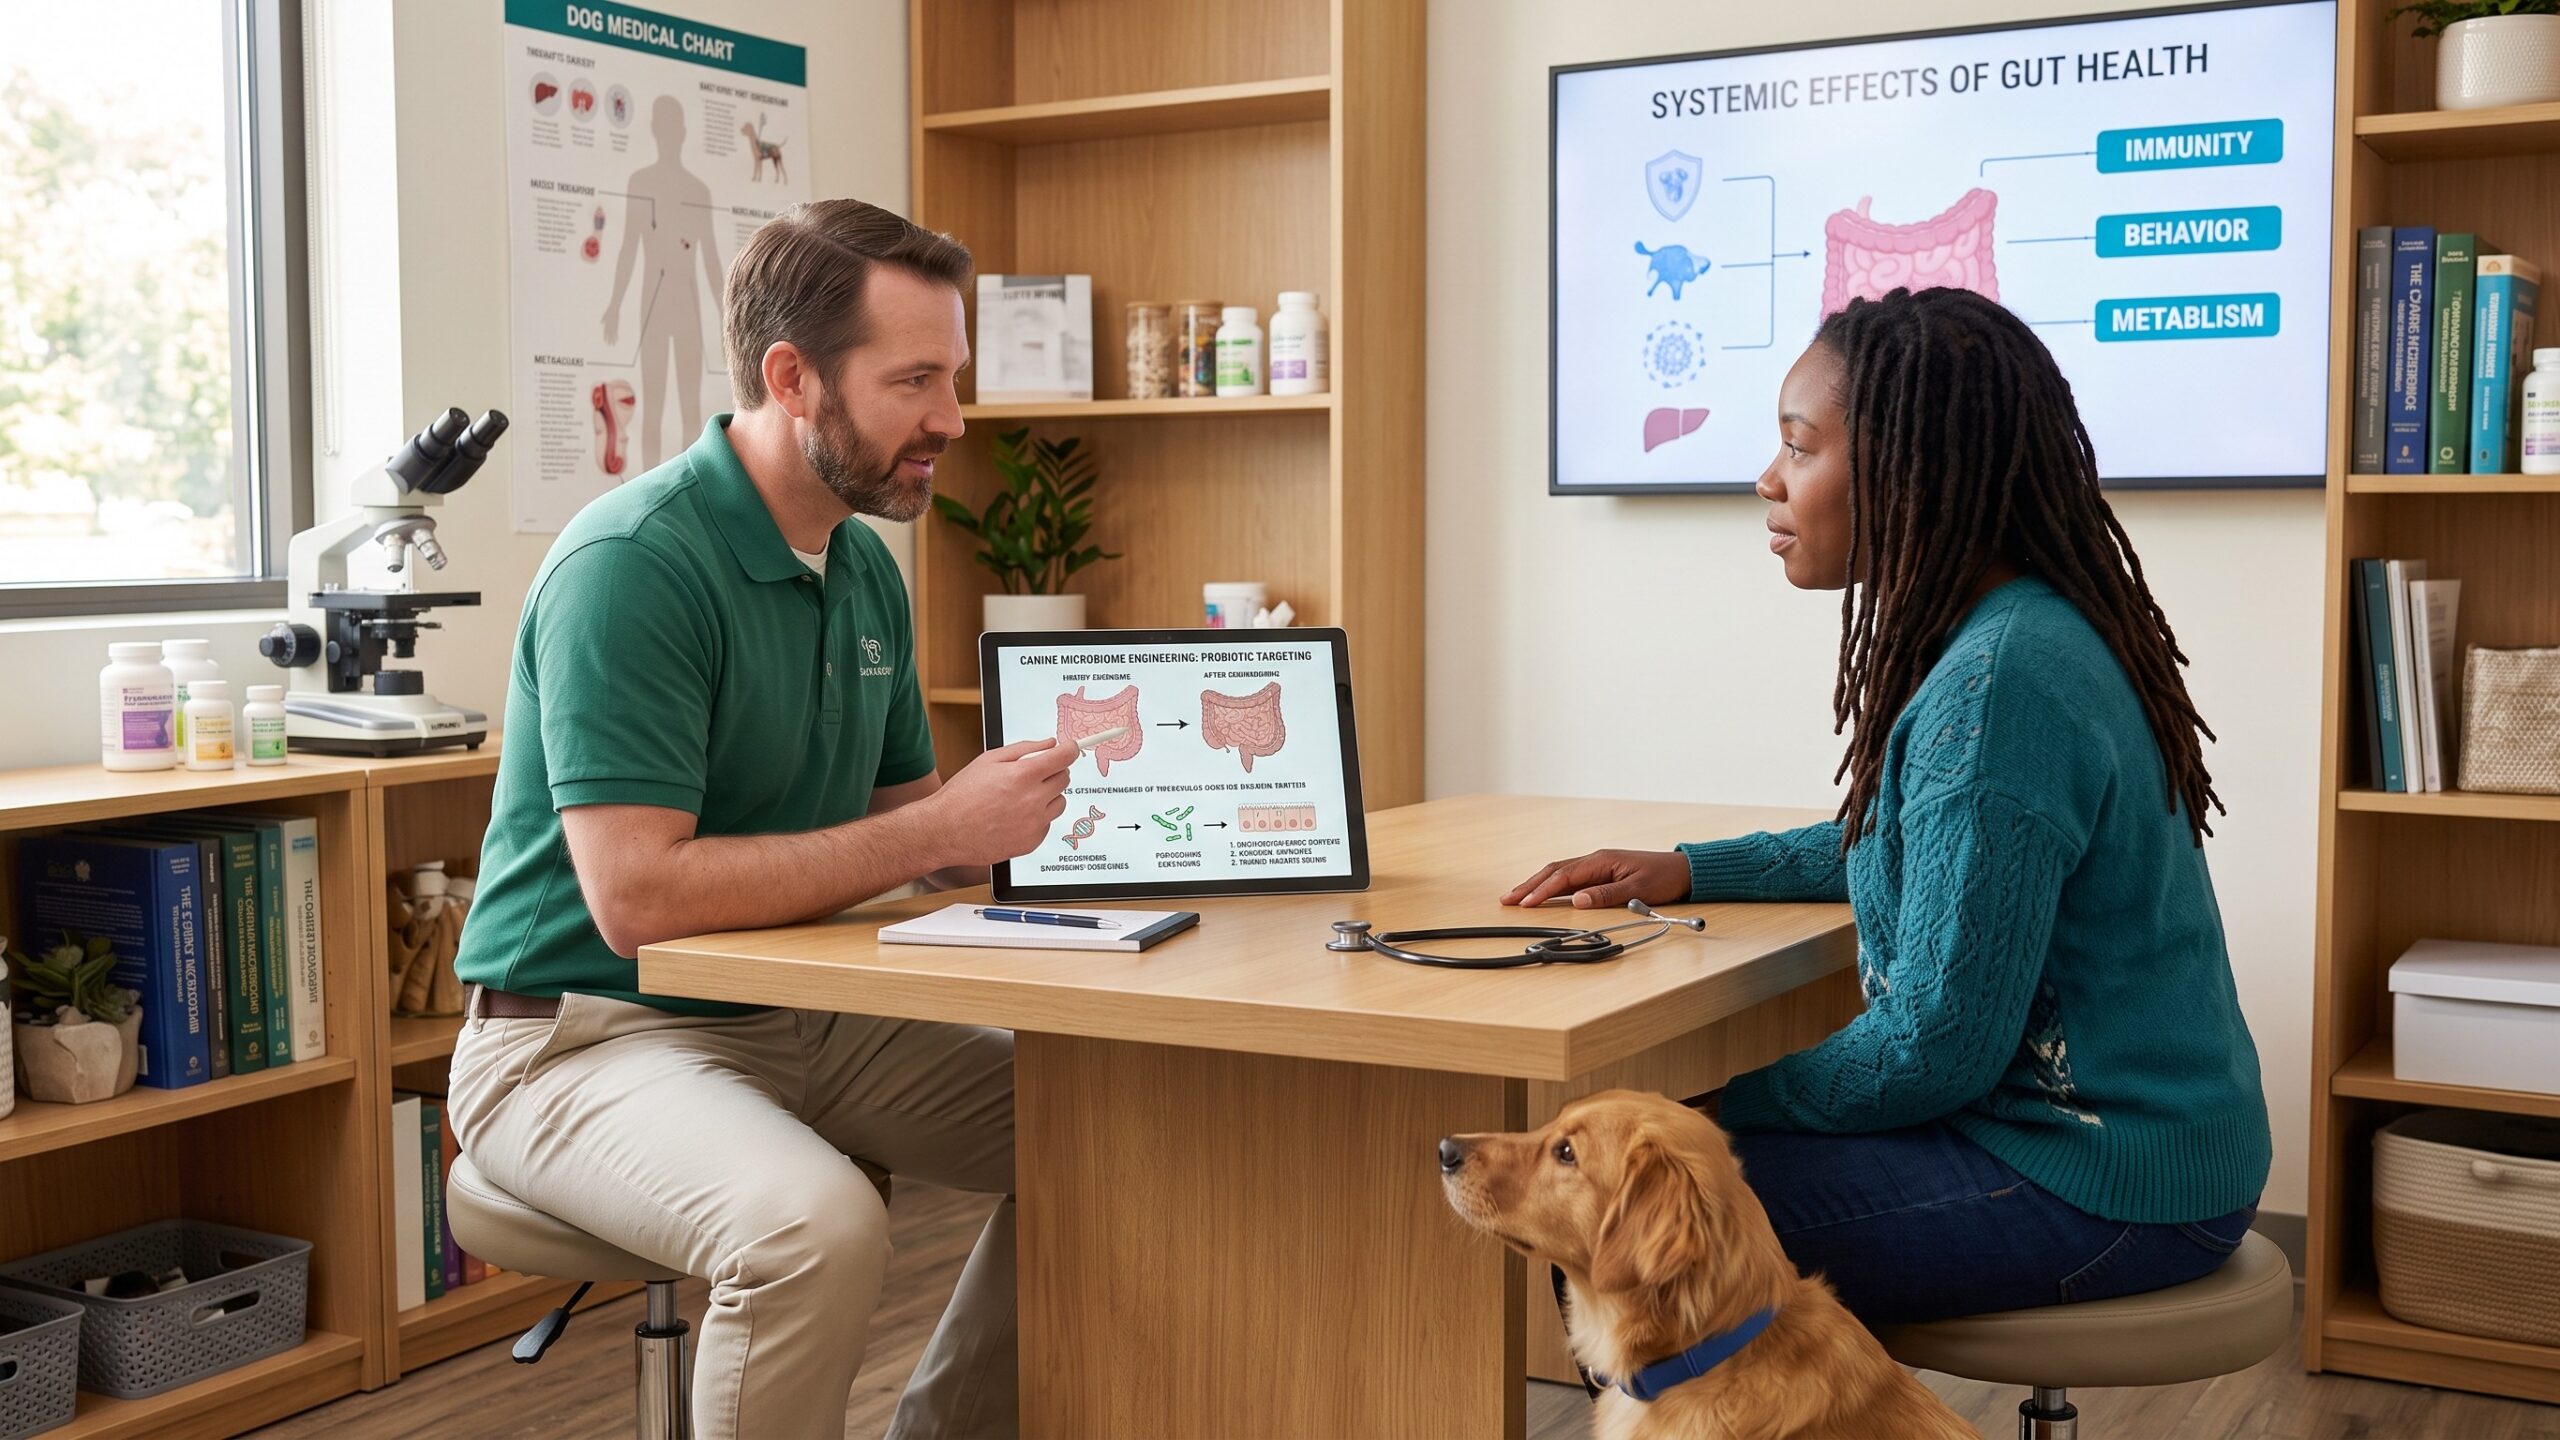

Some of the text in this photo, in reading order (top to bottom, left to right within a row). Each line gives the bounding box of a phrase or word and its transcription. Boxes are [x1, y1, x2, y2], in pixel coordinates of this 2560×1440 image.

[566, 4, 735, 62] DOG MEDICAL CHART
[1651, 43, 2209, 120] SYSTEMIC EFFECTS OF GUT HEALTH
[2124, 130, 2254, 163] IMMUNITY
[2123, 217, 2250, 248] BEHAVIOR
[2111, 303, 2264, 333] METABLISM
[1020, 651, 1312, 665] CANINE MICROBIOME ENGINEERING: PROBIOTIC TARGETING
